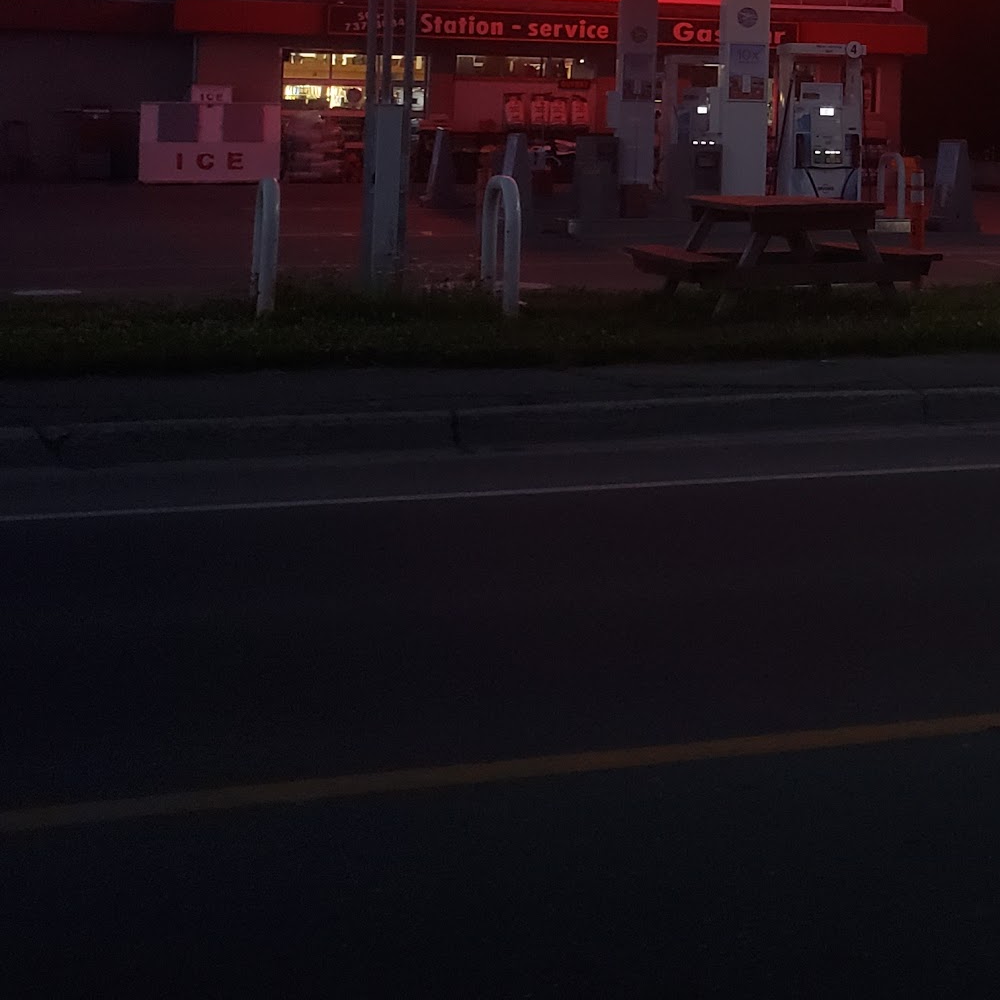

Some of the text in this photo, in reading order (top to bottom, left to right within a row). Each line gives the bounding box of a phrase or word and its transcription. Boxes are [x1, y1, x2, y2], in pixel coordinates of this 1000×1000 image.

[420, 13, 504, 36] Station
[527, 19, 609, 39] service
[850, 44, 858, 55] 4
[200, 93, 223, 102] ICE
[176, 152, 244, 170] ICE
